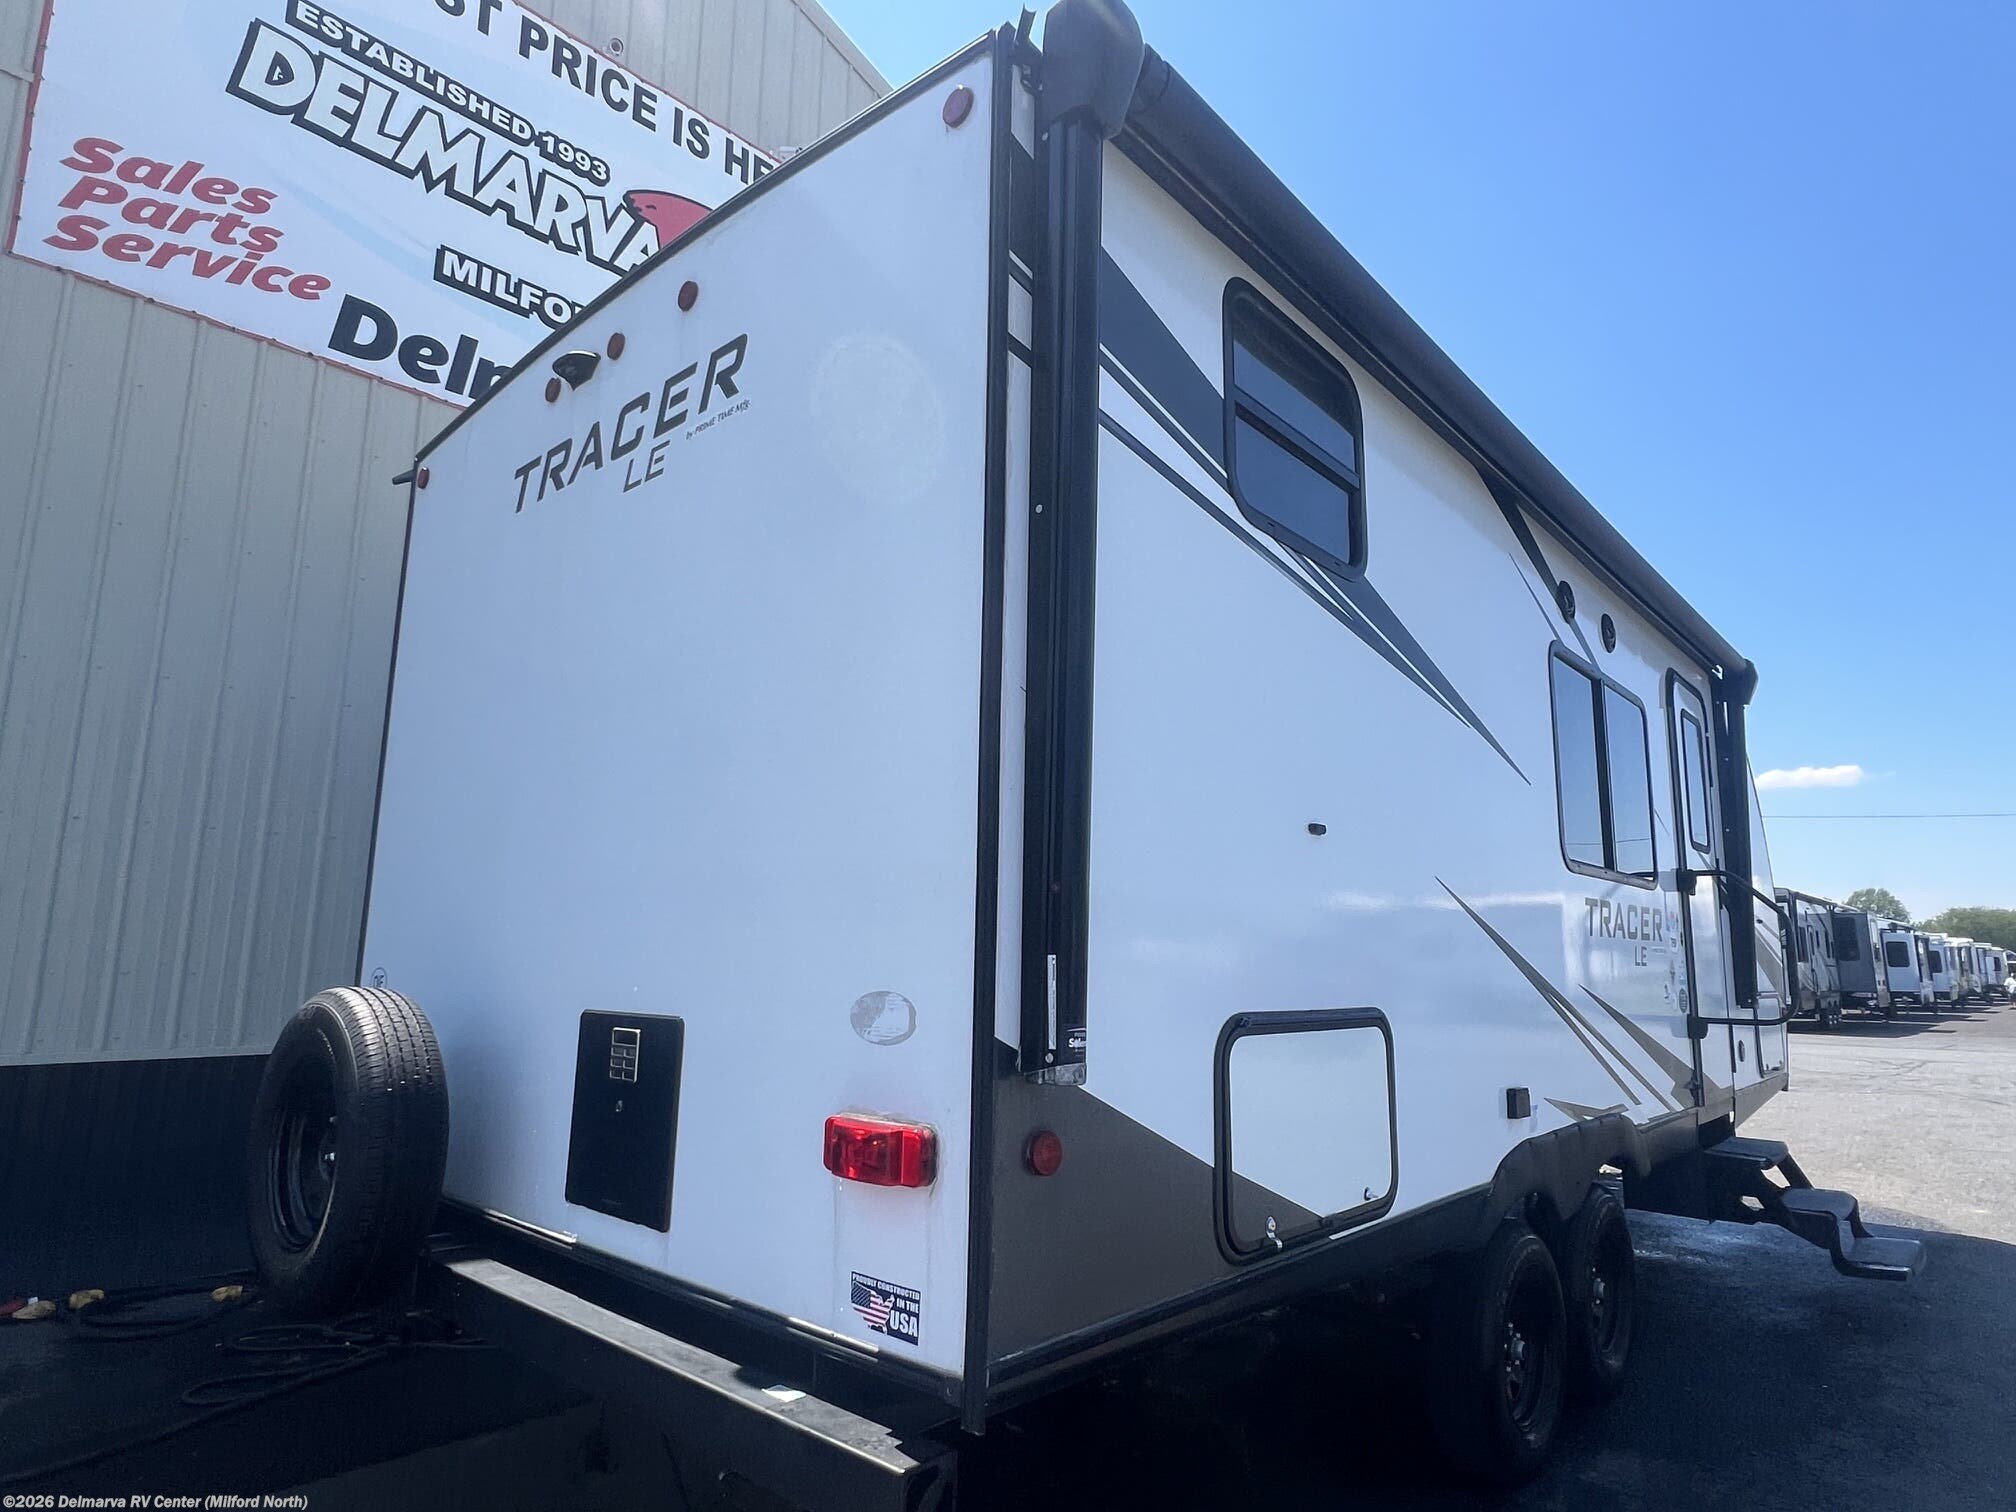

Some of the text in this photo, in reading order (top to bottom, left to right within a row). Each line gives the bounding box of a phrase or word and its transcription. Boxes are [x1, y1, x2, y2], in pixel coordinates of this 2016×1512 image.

[296, 7, 608, 182] ESTABLISHED 1993
[519, 15, 659, 132] PRICE
[673, 106, 710, 160] IS
[60, 137, 279, 215] Sales
[227, 18, 661, 273] DELMARVA
[58, 175, 284, 254] Parts
[43, 214, 332, 301] Service
[440, 248, 584, 325] MILFO
[514, 333, 748, 514] TRACER
[623, 439, 671, 493] LE
[1584, 897, 1663, 942] TRACER
[1634, 944, 1648, 967] LE
[877, 1281, 920, 1300] CONSTRUCTED
[889, 1309, 918, 1337] USA
[896, 1297, 919, 1314] IN THE
